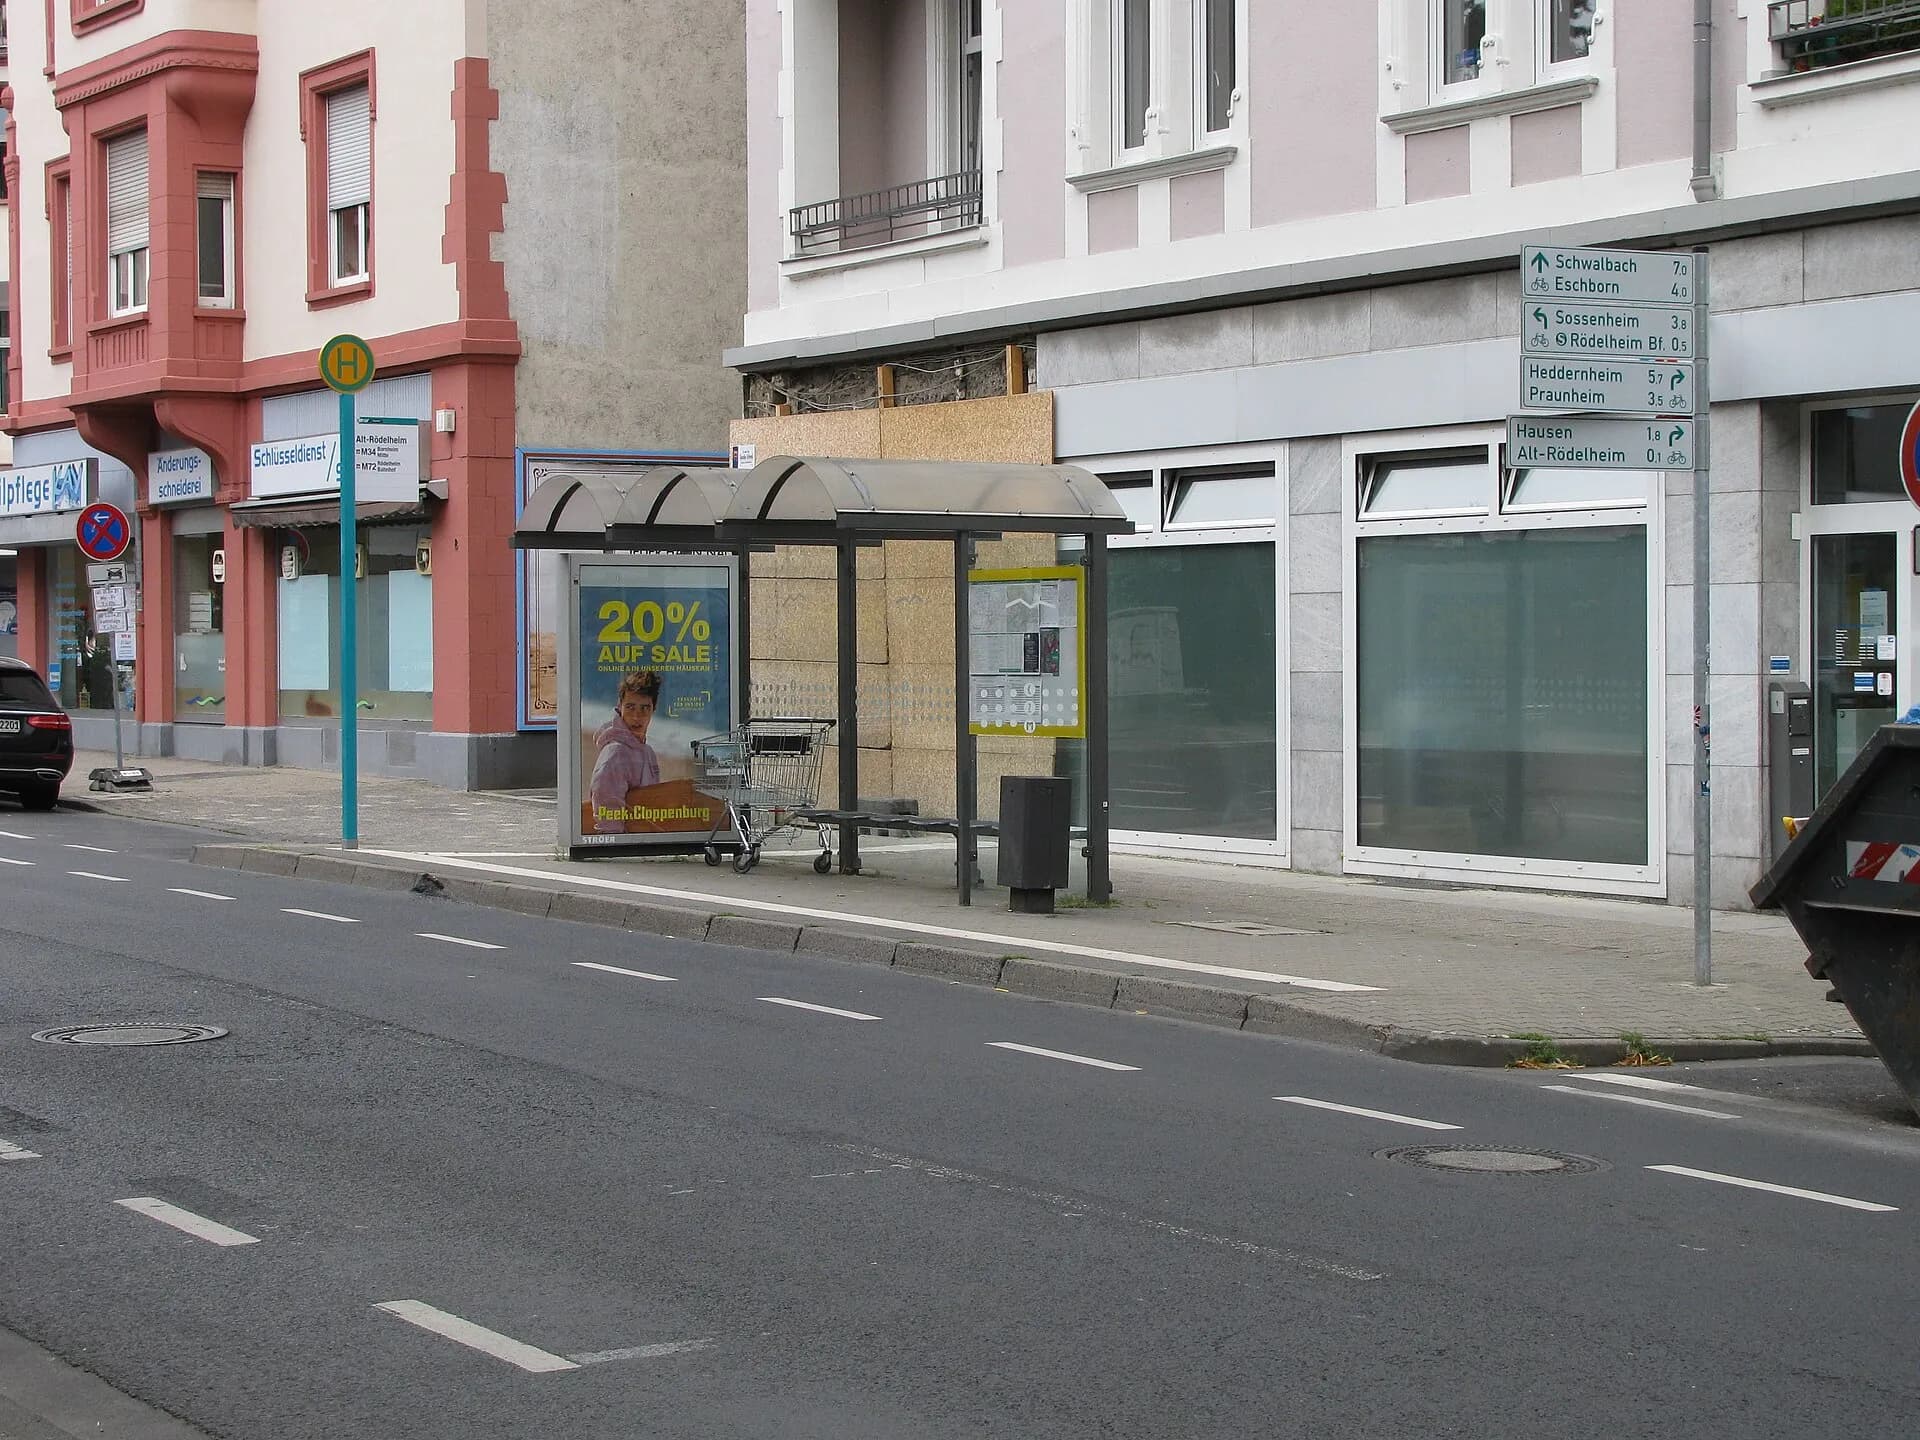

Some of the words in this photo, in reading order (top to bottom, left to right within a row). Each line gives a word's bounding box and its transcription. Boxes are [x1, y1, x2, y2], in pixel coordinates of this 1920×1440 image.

[1556, 254, 1637, 273] Schwalbach
[1555, 277, 1620, 294] Eschborn
[1556, 310, 1639, 328] Sossenheim
[1570, 332, 1642, 350] Rödelheim
[1648, 336, 1666, 351] Bf.
[337, 348, 358, 379] H
[1530, 364, 1622, 382] Heddernheim
[1530, 387, 1605, 404] Praunheim
[356, 435, 408, 444] Alt-Rödelheim
[1516, 424, 1572, 439] Hausen
[254, 441, 326, 468] Schlüsseldienst
[361, 448, 376, 456] M34
[1517, 446, 1625, 463] Alt-Rödelheim
[157, 455, 202, 474] Änderungs-
[362, 463, 376, 471] M72
[158, 476, 202, 498] schneiderei
[598, 600, 710, 643] 20%
[598, 645, 644, 663] AUF
[652, 645, 710, 663] SALE
